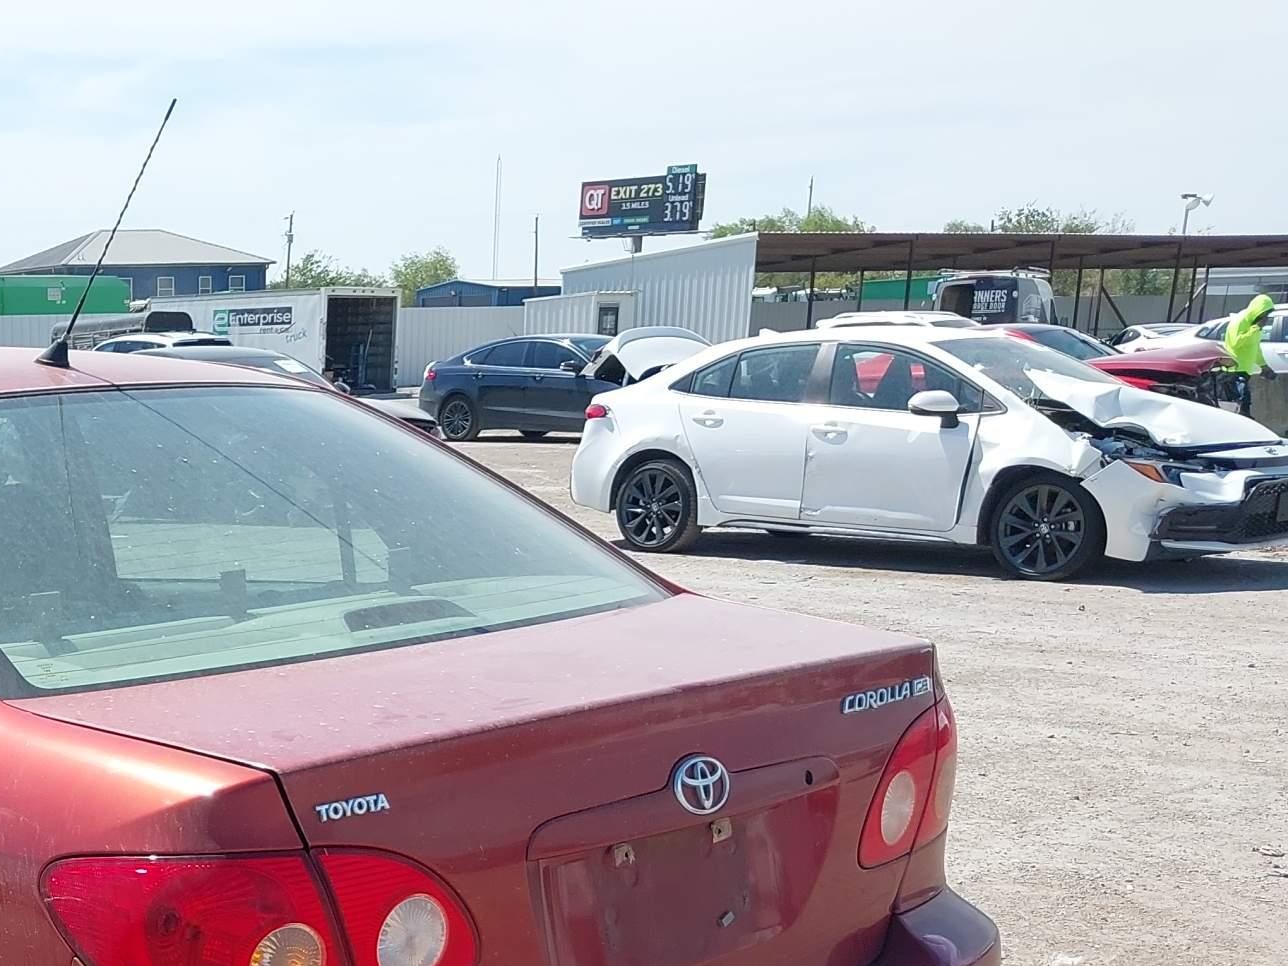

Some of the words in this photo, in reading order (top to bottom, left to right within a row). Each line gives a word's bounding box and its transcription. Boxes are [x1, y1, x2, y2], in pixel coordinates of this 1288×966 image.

[585, 189, 605, 211] QT
[610, 185, 638, 200] EXIT
[639, 183, 663, 198] 273
[631, 201, 650, 209] MILES
[229, 310, 292, 326] Enterprise
[843, 681, 911, 714] COROLLA
[315, 793, 390, 823] TOYOTA
